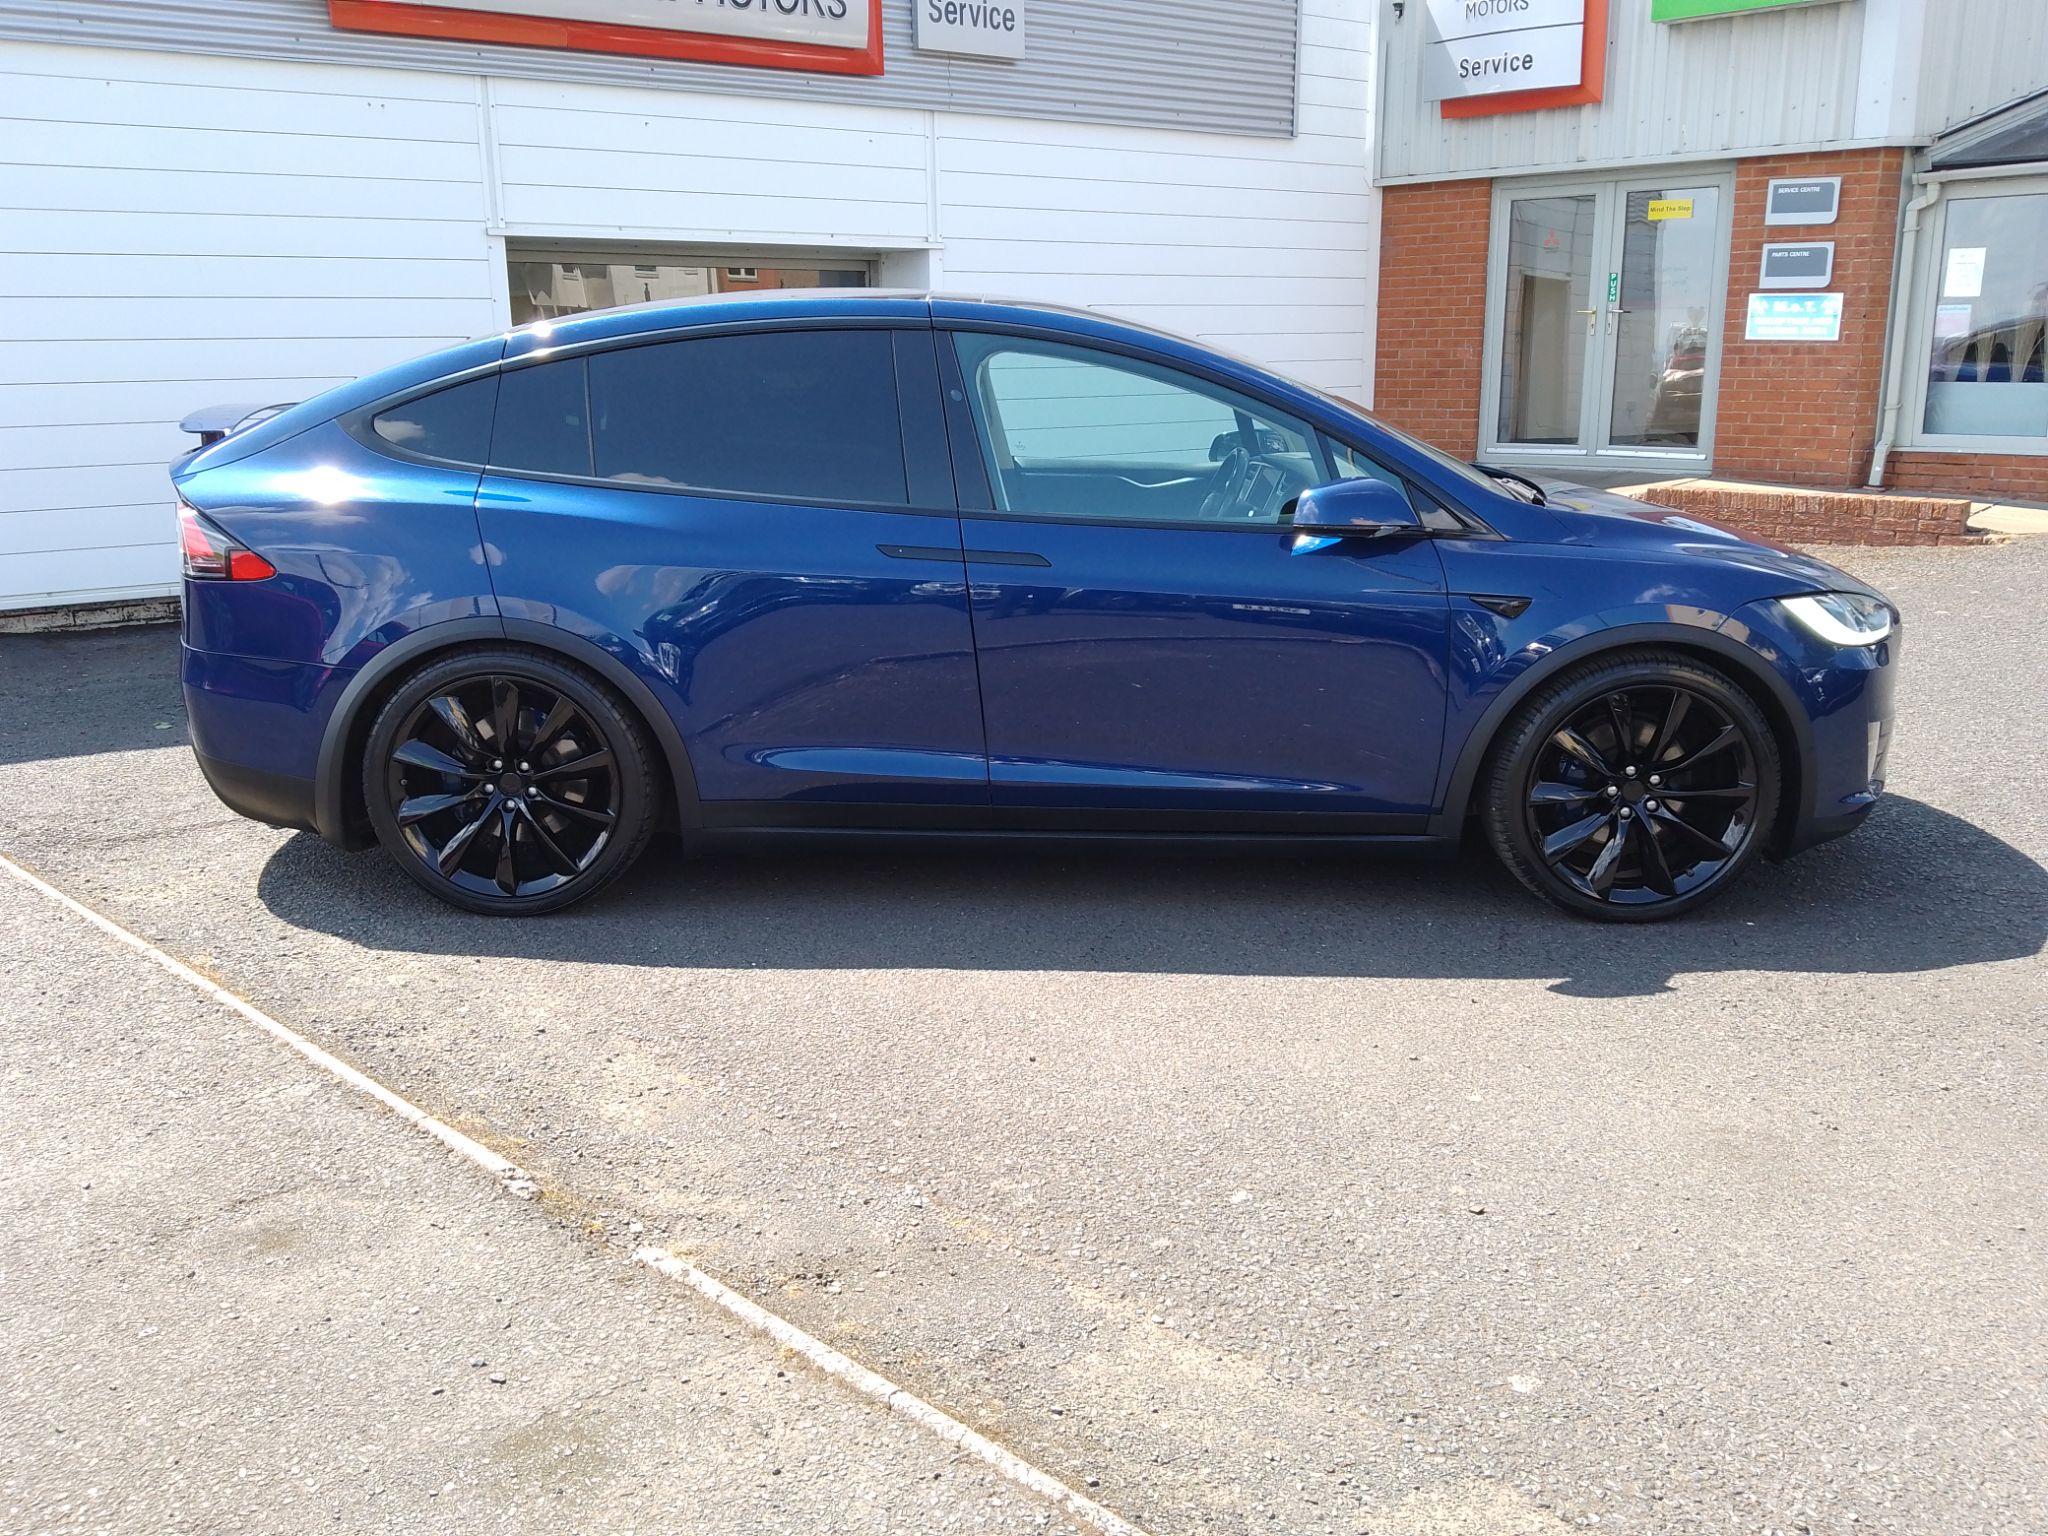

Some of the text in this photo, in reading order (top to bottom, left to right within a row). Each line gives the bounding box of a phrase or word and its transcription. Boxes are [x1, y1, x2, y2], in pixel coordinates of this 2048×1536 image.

[694, 0, 848, 19] ORS
[928, 0, 1015, 31] Service
[1465, 0, 1529, 19] MOTORS
[1458, 52, 1533, 78] Service
[1609, 273, 1617, 301] PUSH
